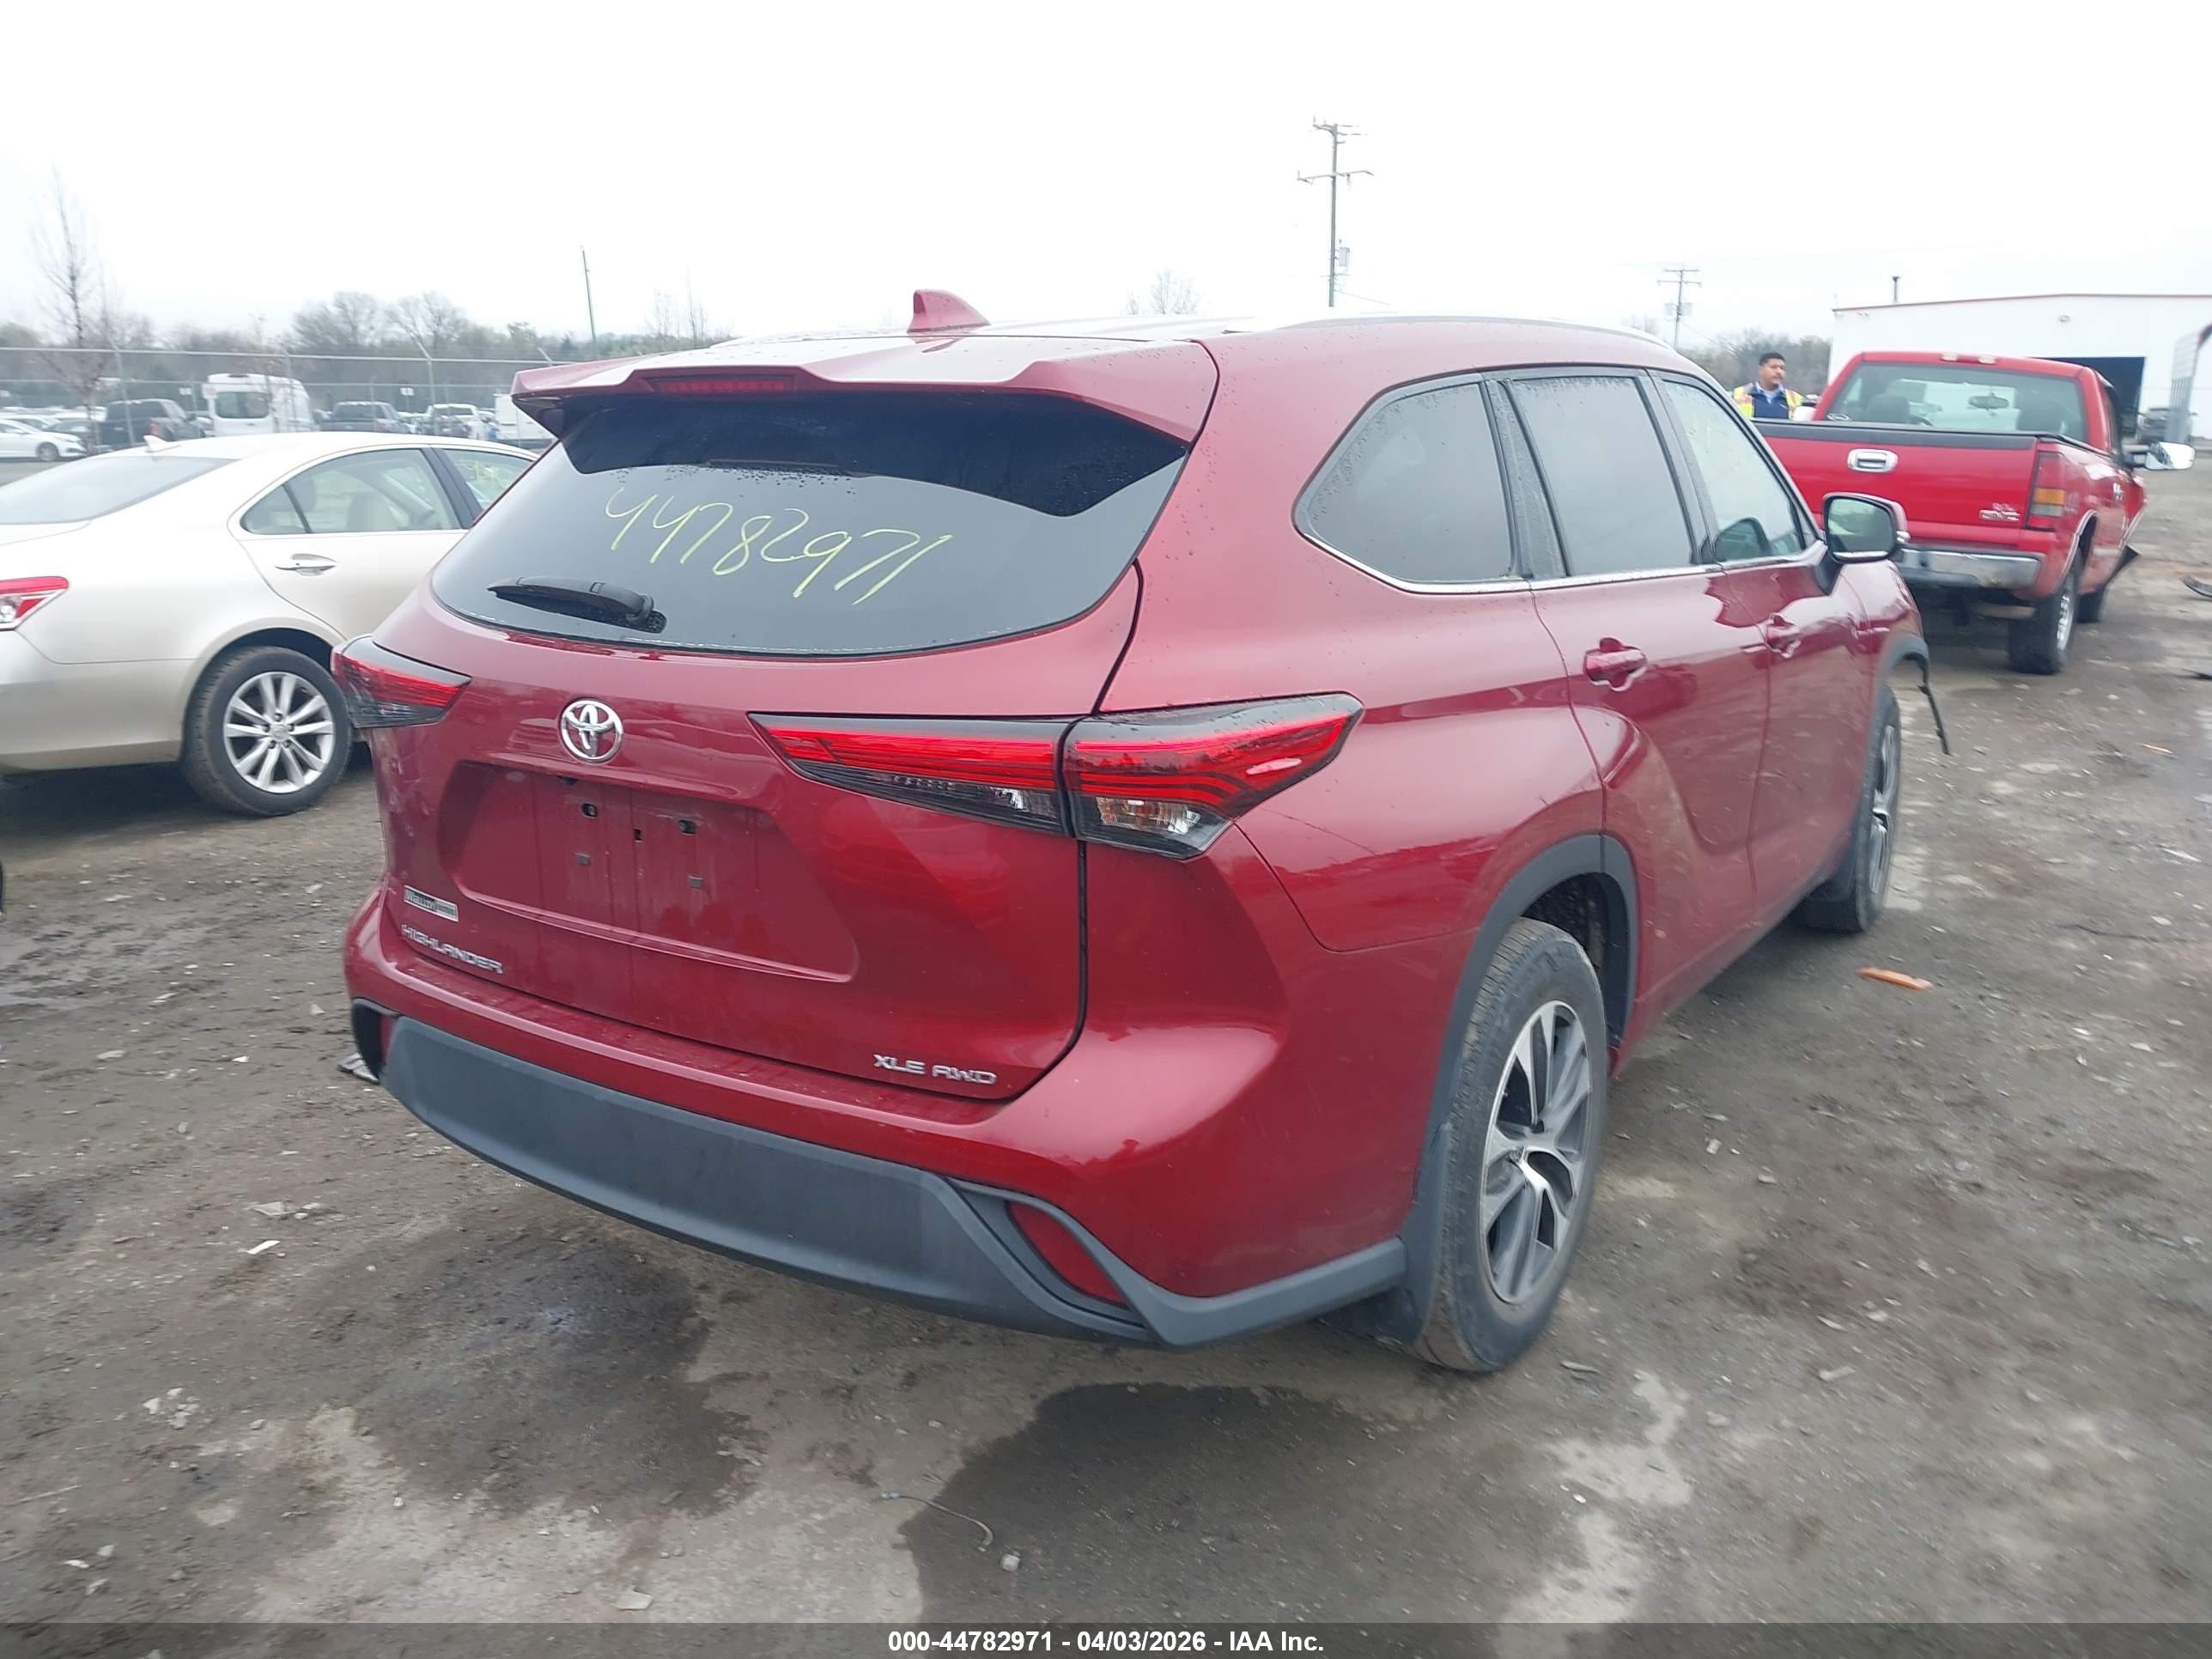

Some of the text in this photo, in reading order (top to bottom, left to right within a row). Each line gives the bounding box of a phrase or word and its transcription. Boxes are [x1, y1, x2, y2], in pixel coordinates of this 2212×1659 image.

[605, 487, 953, 605] 44782971
[401, 924, 503, 975] HIGHLANDER
[873, 1054, 997, 1085] XLE AWD
